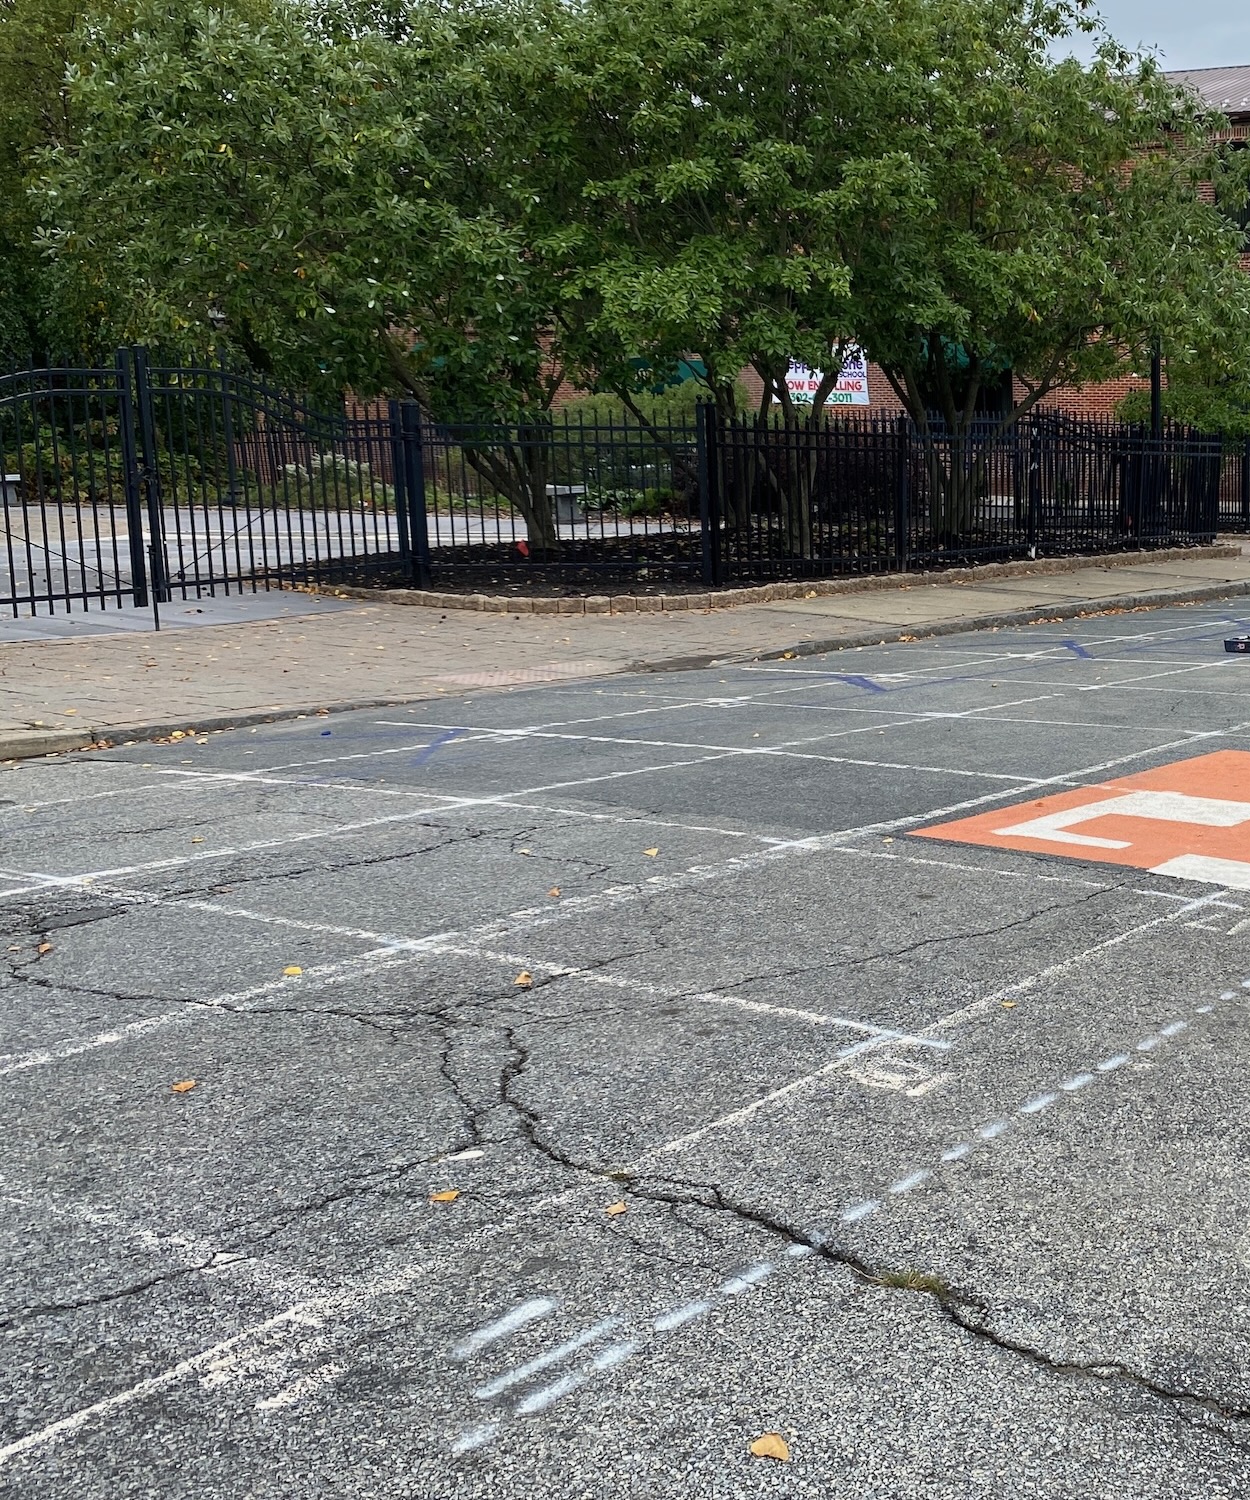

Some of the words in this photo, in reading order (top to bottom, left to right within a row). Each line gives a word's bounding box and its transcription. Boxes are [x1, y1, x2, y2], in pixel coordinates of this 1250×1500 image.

[787, 381, 805, 391] OW
[808, 381, 862, 391] ENLING
[790, 392, 852, 403] 302--3011
